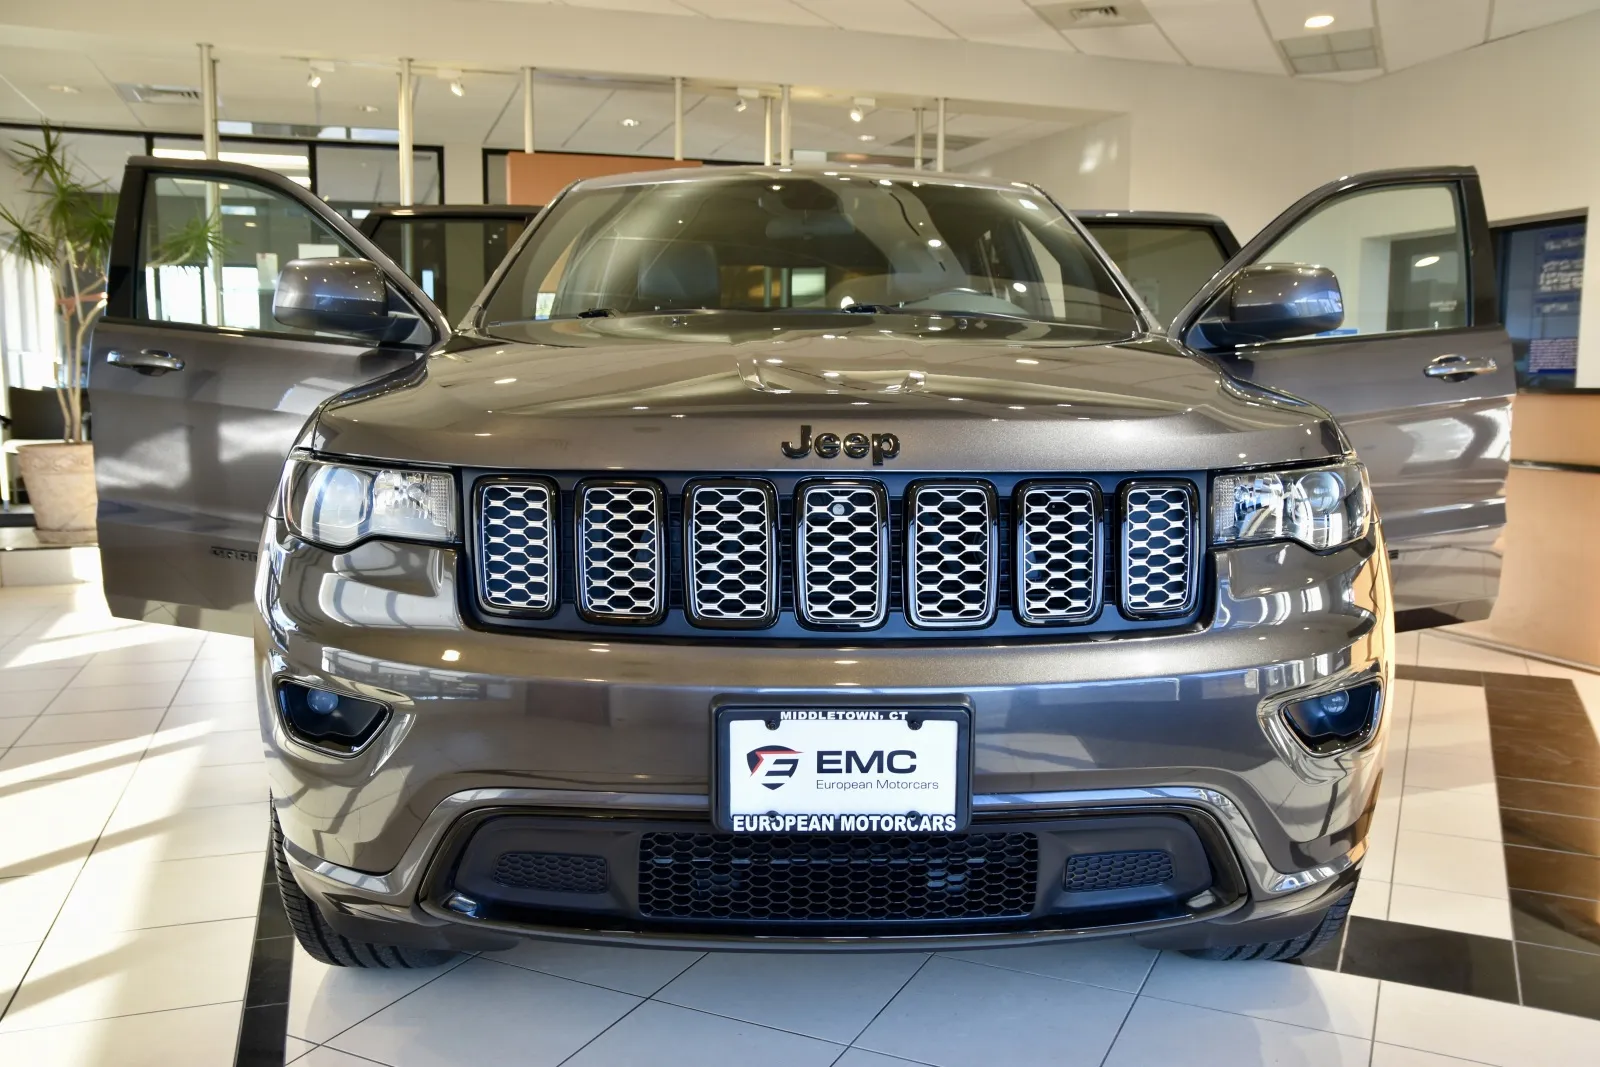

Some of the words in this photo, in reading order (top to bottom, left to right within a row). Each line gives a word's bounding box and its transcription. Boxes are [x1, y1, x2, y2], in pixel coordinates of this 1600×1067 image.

[781, 425, 900, 466] Jeep
[780, 711, 884, 721] MIDDLETOWN,
[888, 711, 909, 721] CT
[816, 750, 917, 774] EMC
[816, 779, 873, 791] European
[876, 779, 939, 790] Motorcars
[733, 815, 834, 832] EUROPEAN
[840, 815, 957, 832] MOTORCARS
